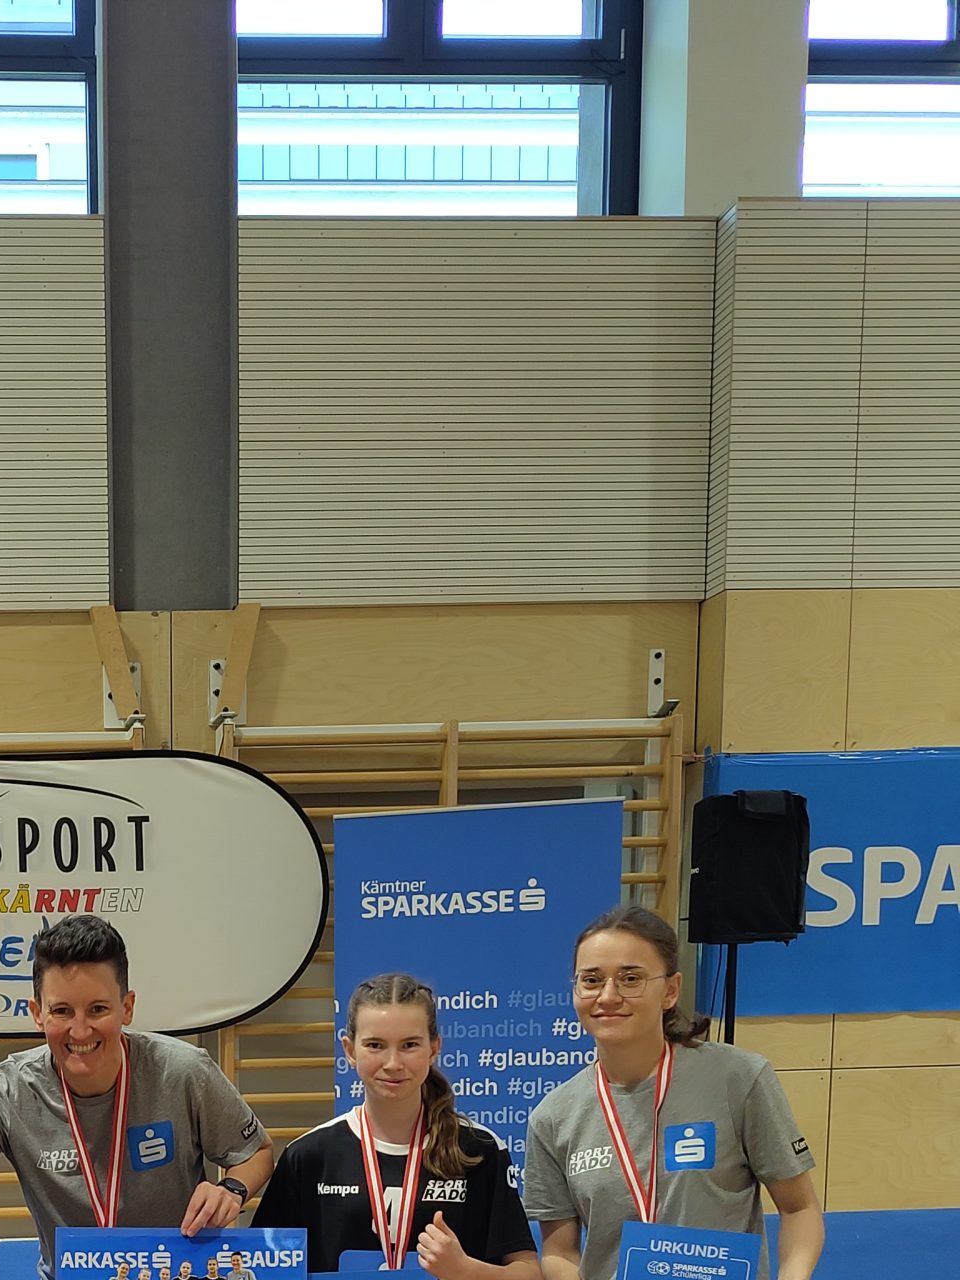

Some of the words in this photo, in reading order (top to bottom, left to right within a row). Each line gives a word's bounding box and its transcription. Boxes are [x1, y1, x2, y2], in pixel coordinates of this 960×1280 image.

[361, 879, 427, 896] Kärntner
[361, 889, 515, 919] SPARKASSE
[569, 1145, 613, 1163] SPORT
[569, 1154, 613, 1176] RADO
[317, 1182, 359, 1198] Kempa
[650, 1239, 728, 1259] URKUNDE
[61, 1251, 149, 1269] ARKASSE
[673, 1263, 717, 1274] SPARKASSE
[672, 1270, 712, 1280] Schülerliga
